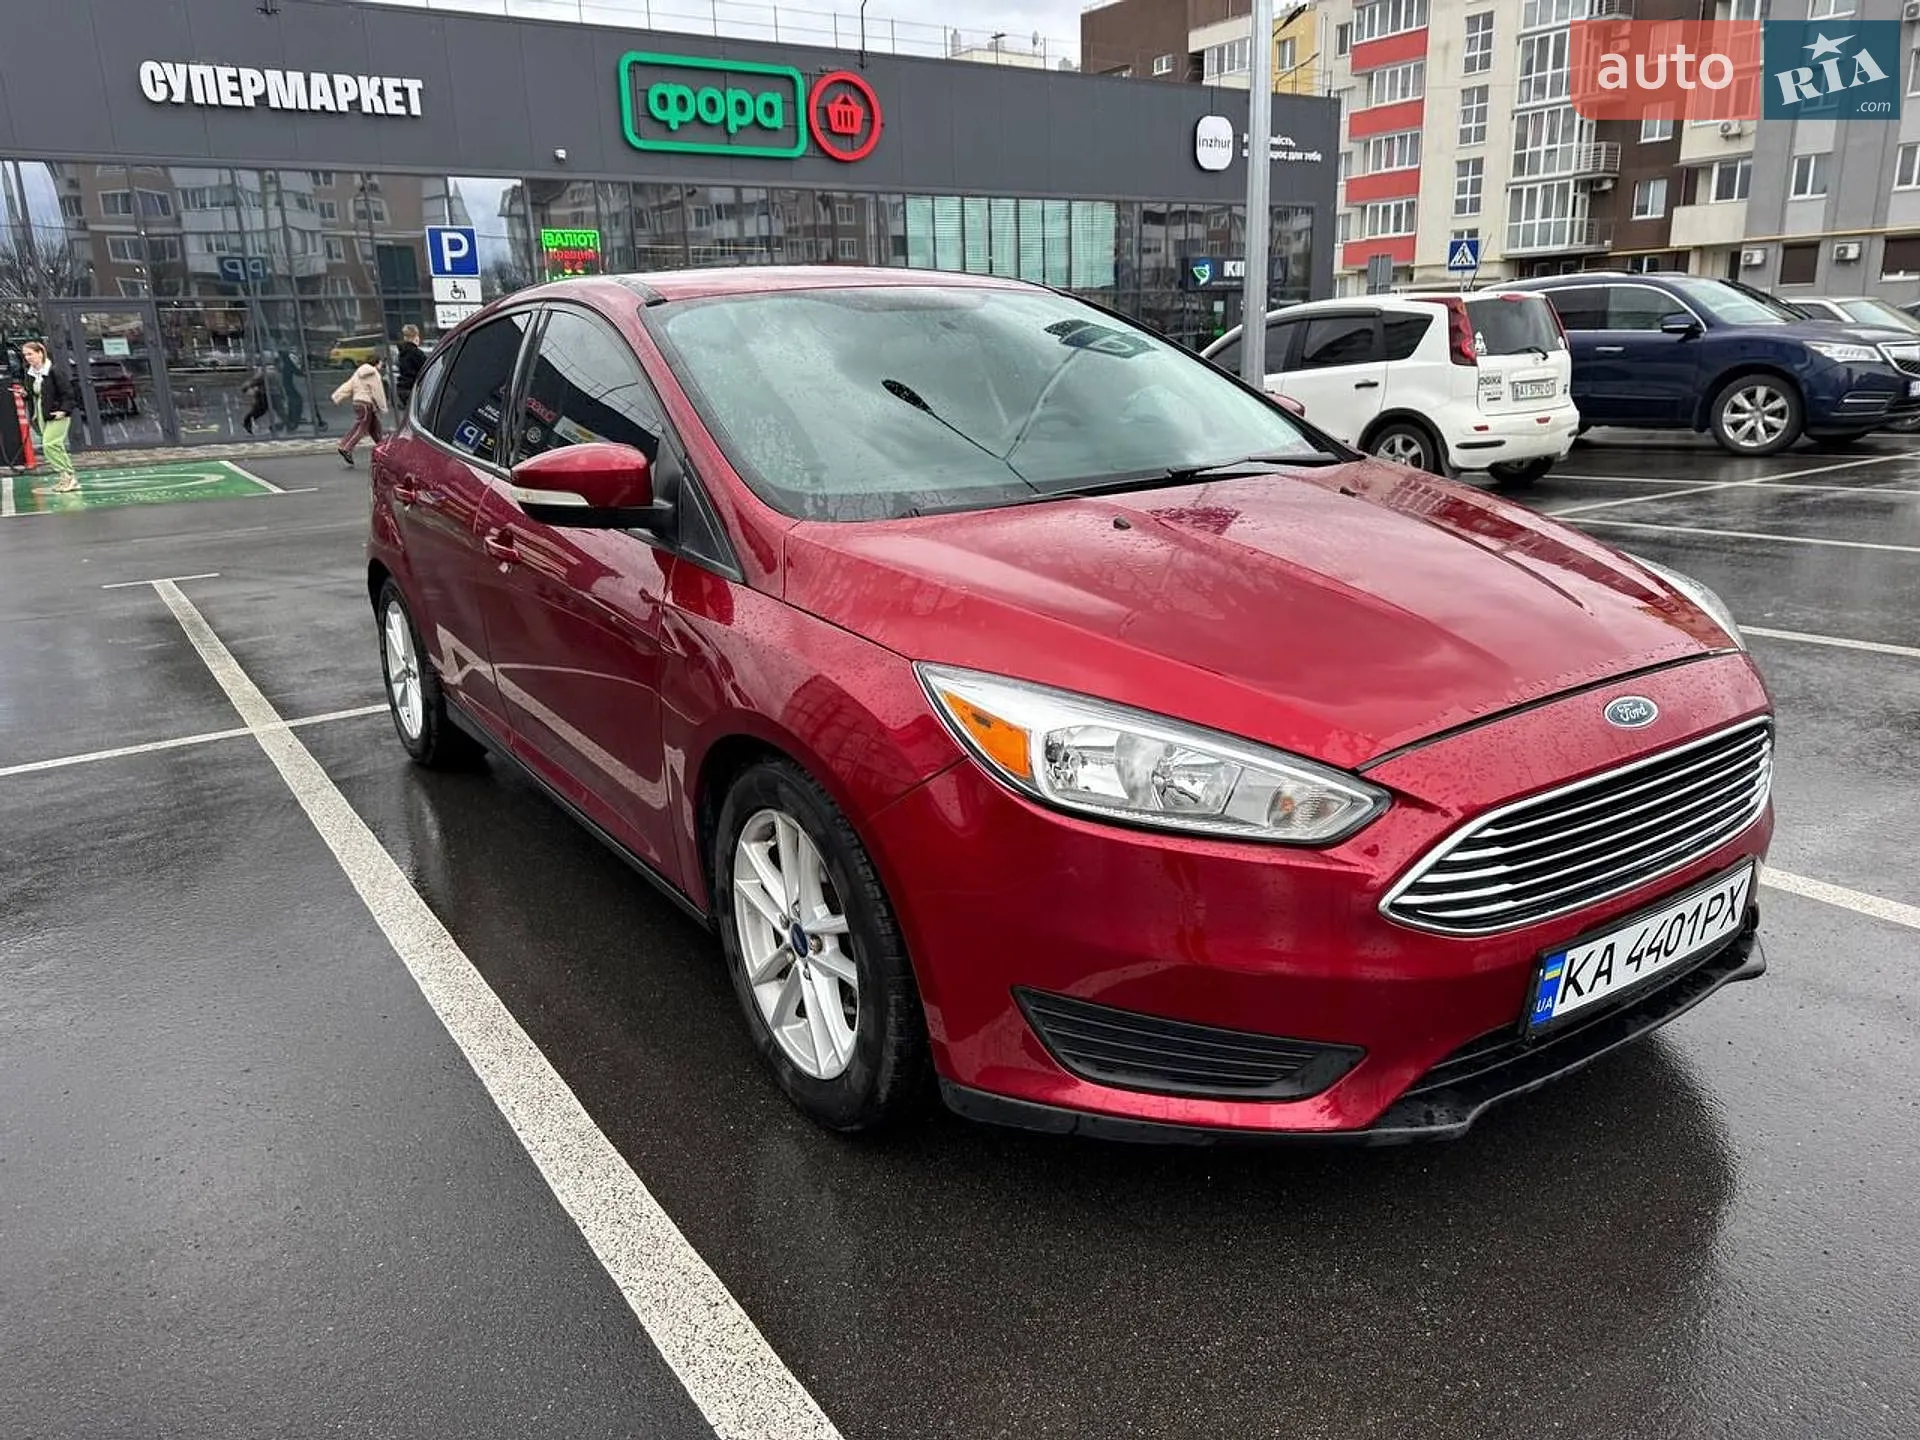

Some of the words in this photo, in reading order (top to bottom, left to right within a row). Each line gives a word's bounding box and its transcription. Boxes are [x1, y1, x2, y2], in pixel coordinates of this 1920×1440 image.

[139, 60, 423, 116] СУПЕРМАРКЕТ
[648, 82, 784, 134] фора
[1198, 136, 1231, 149] inzhur
[441, 231, 469, 272] P
[1616, 702, 1648, 721] Ford
[1559, 942, 1616, 1004] KA
[1536, 997, 1553, 1013] UA
